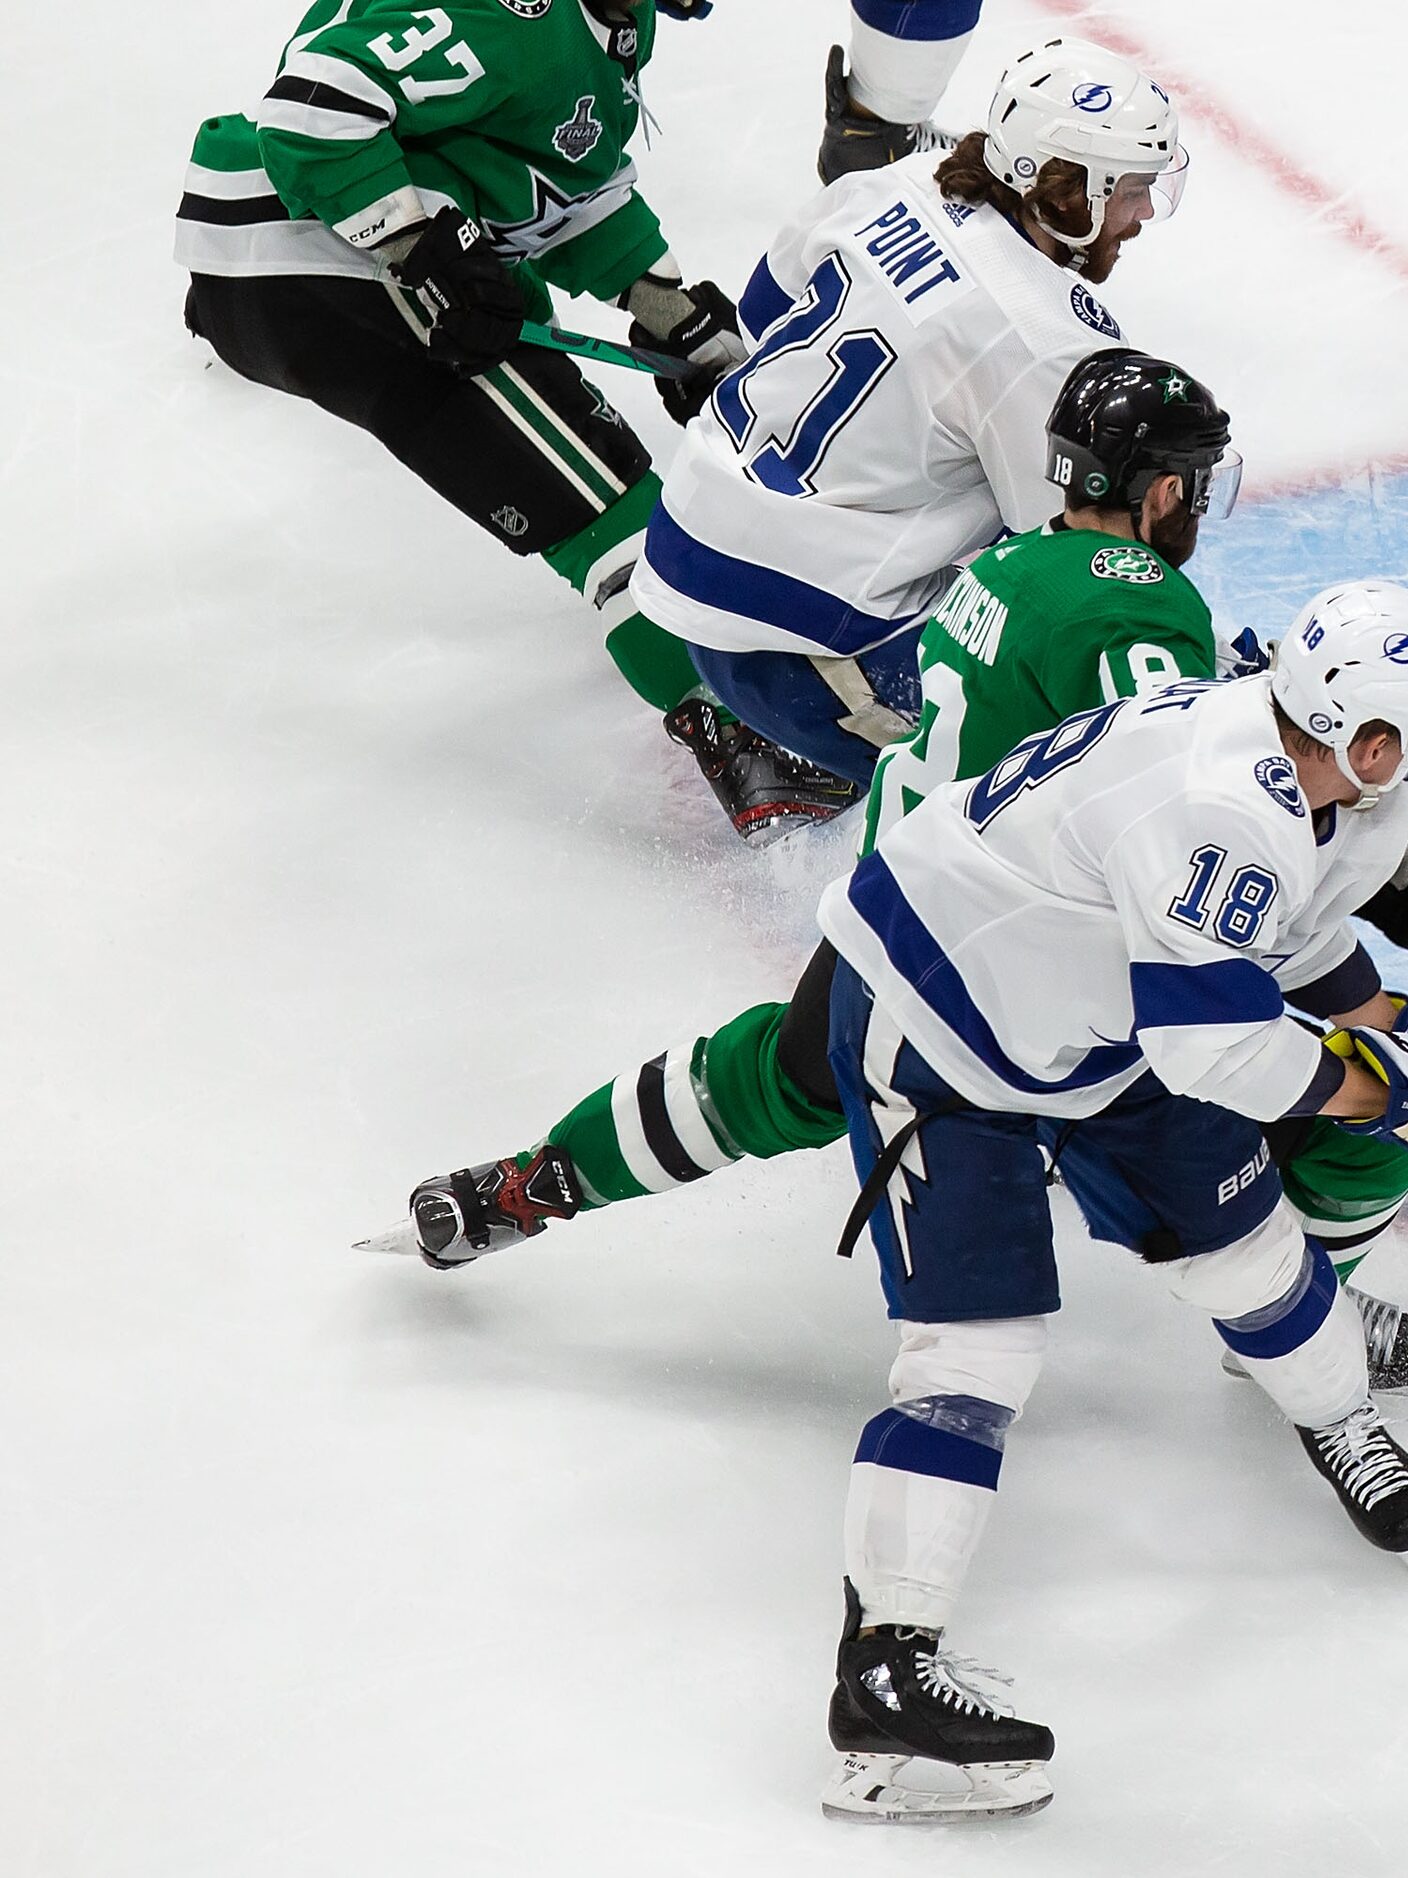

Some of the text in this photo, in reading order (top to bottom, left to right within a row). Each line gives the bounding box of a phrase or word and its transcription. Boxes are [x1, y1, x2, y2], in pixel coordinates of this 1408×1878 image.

[367, 7, 486, 104] 37
[349, 218, 386, 243] CCM
[854, 201, 961, 304] POINT
[712, 250, 897, 499] 21
[1053, 454, 1073, 486] 18
[1302, 617, 1326, 651] 18
[1167, 842, 1280, 950] 18
[551, 1160, 574, 1204] CCM
